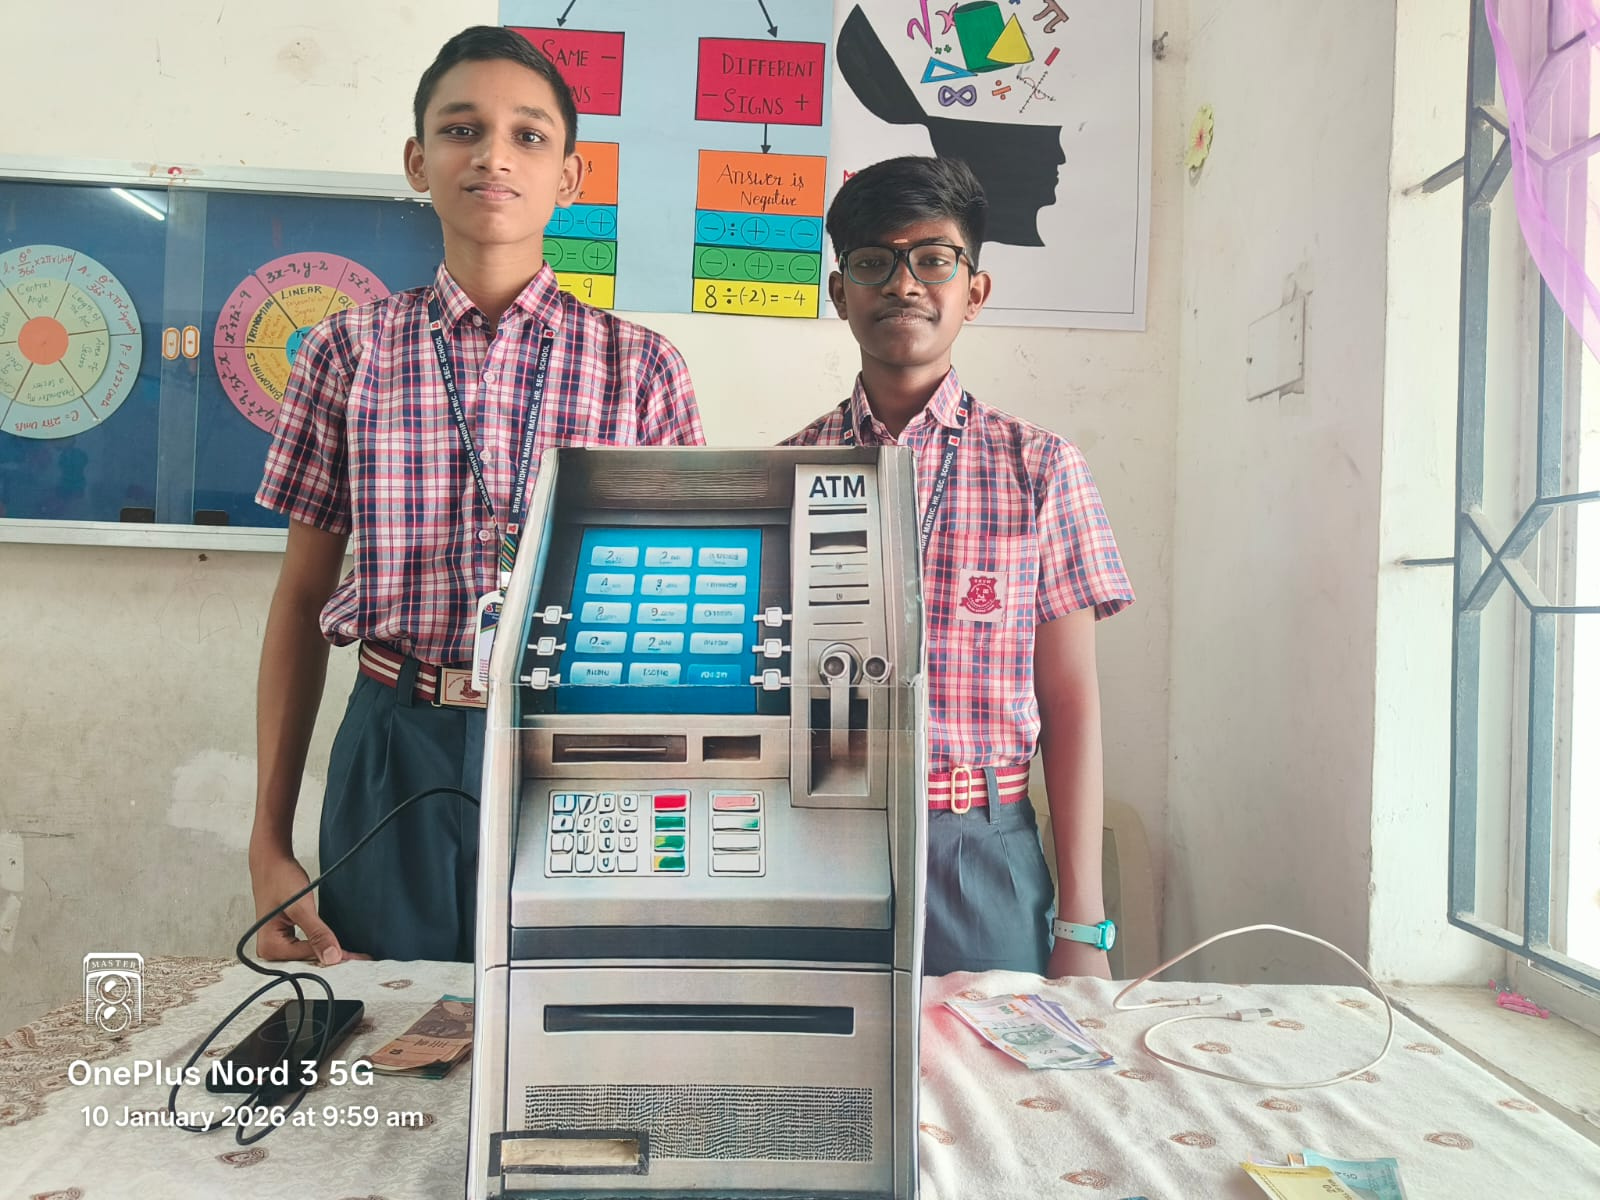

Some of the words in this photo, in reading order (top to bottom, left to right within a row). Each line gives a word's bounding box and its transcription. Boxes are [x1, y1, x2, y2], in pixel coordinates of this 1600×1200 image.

[722, 53, 816, 78] DIFFERENT
[723, 88, 784, 115] SIGNS
[716, 164, 783, 186] Answer
[790, 172, 805, 191] is
[740, 189, 798, 212] Negative
[281, 285, 322, 300] LINEAR
[435, 336, 447, 363] SCHOOL
[539, 344, 550, 371] SCHOOL
[246, 352, 283, 401] BINOMIALS
[523, 431, 534, 458] MANDIR
[519, 460, 528, 485] VIDHYA
[940, 451, 954, 477] SCHOOL
[513, 486, 523, 514] SRIRAM
[809, 475, 866, 498] ATM
